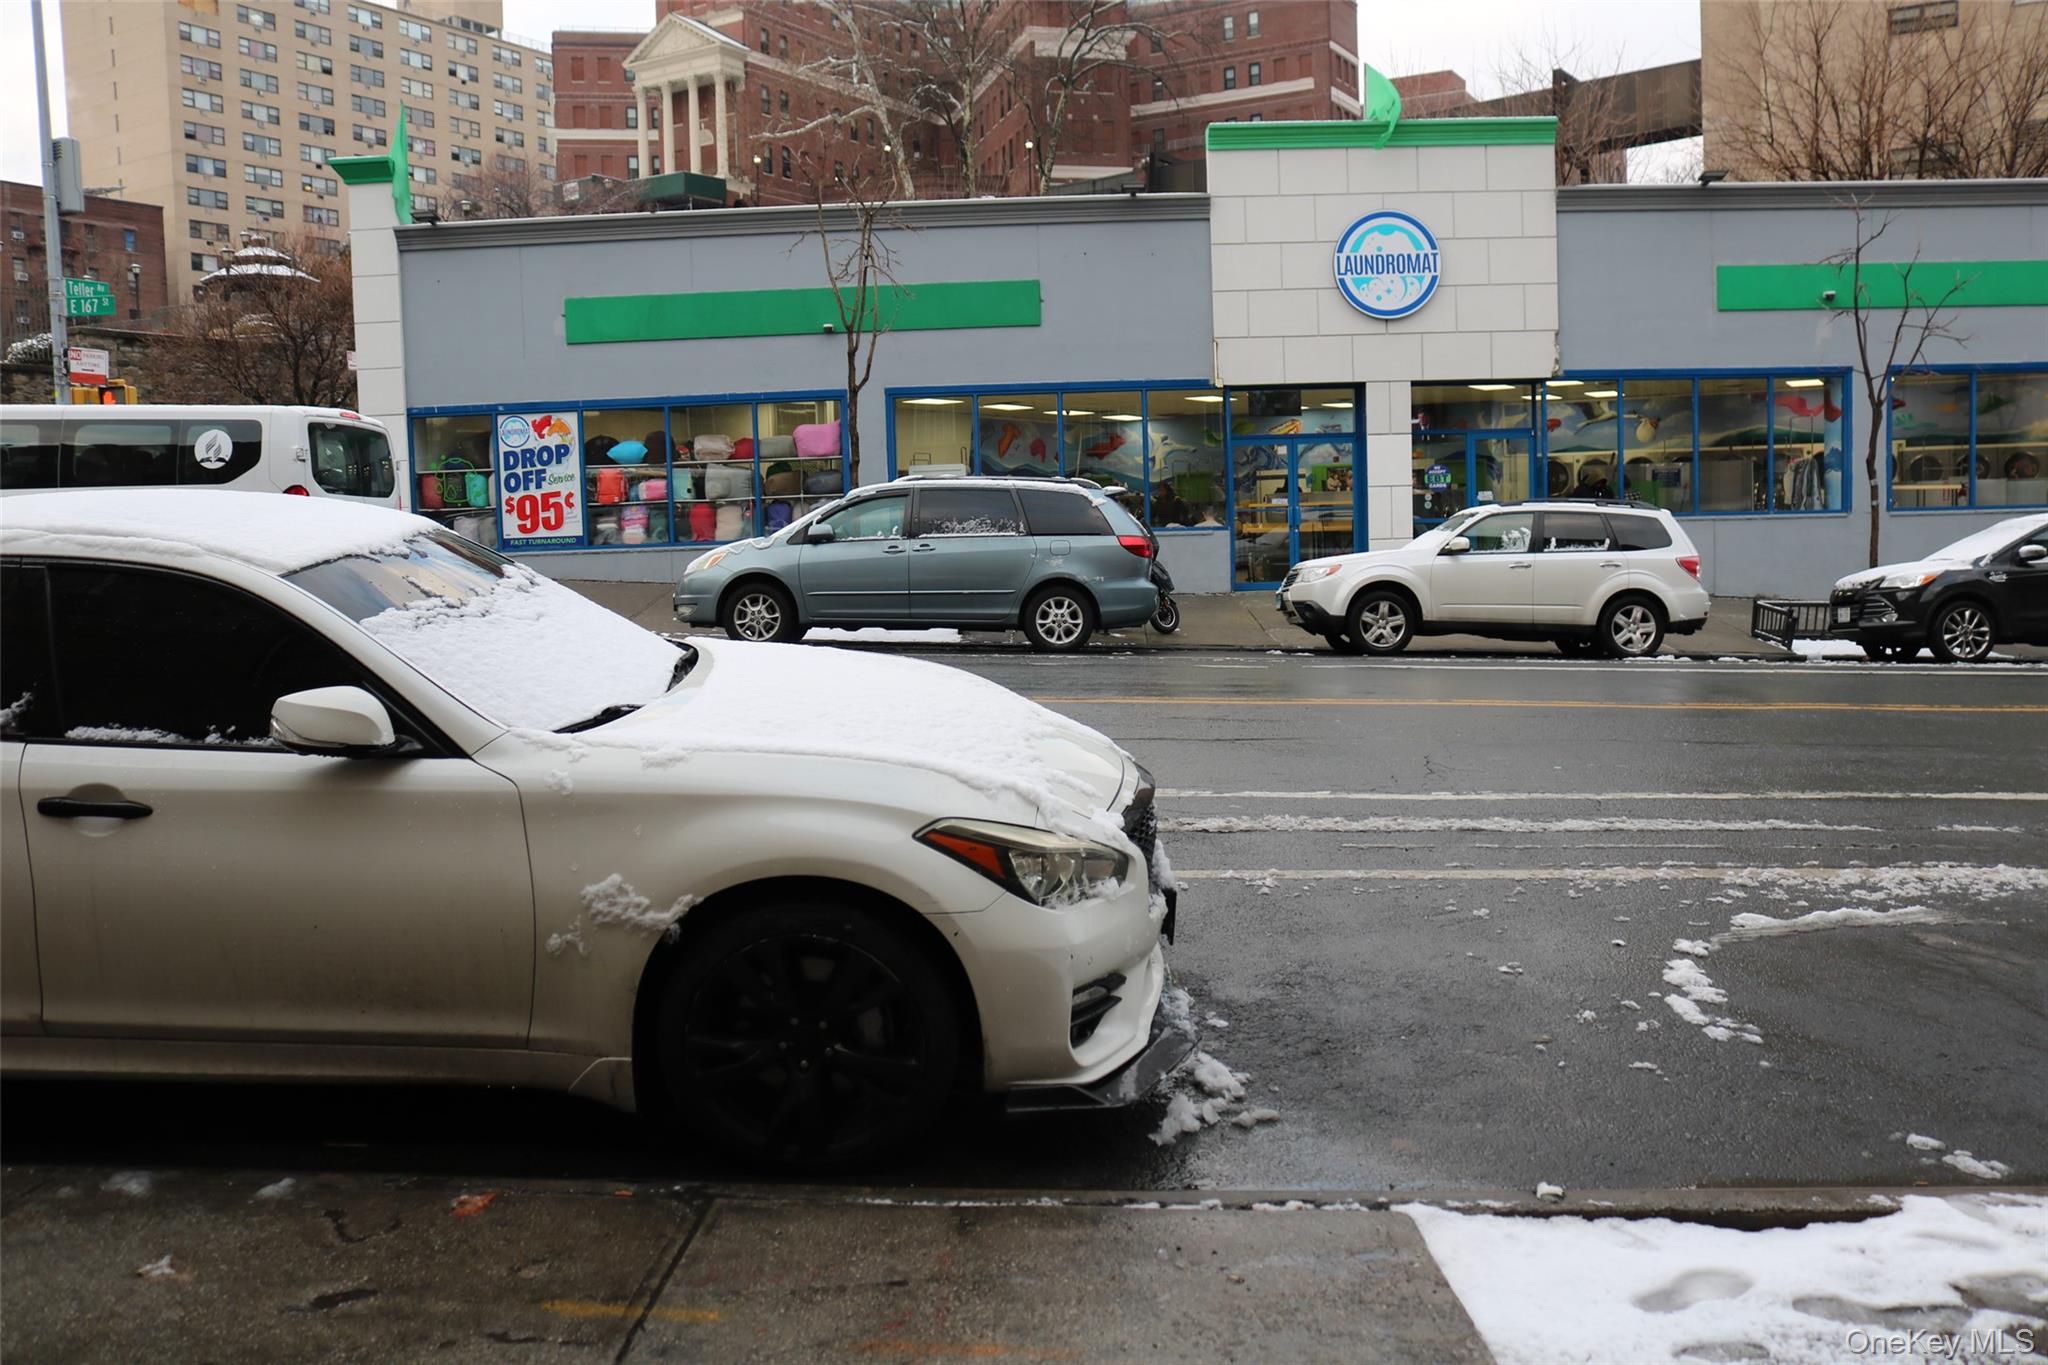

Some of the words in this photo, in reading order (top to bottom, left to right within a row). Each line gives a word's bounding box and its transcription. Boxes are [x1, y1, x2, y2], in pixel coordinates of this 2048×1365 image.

[1336, 252, 1439, 276] LAUNDROMAT
[68, 281, 95, 297] Teller
[70, 299, 77, 314] E
[81, 299, 98, 313] 167
[70, 350, 81, 360] NO
[503, 444, 570, 471] DROP
[504, 469, 547, 493] OFF
[547, 473, 576, 486] Service
[511, 538, 526, 546] FAST
[528, 537, 577, 545] TURNAROUND
